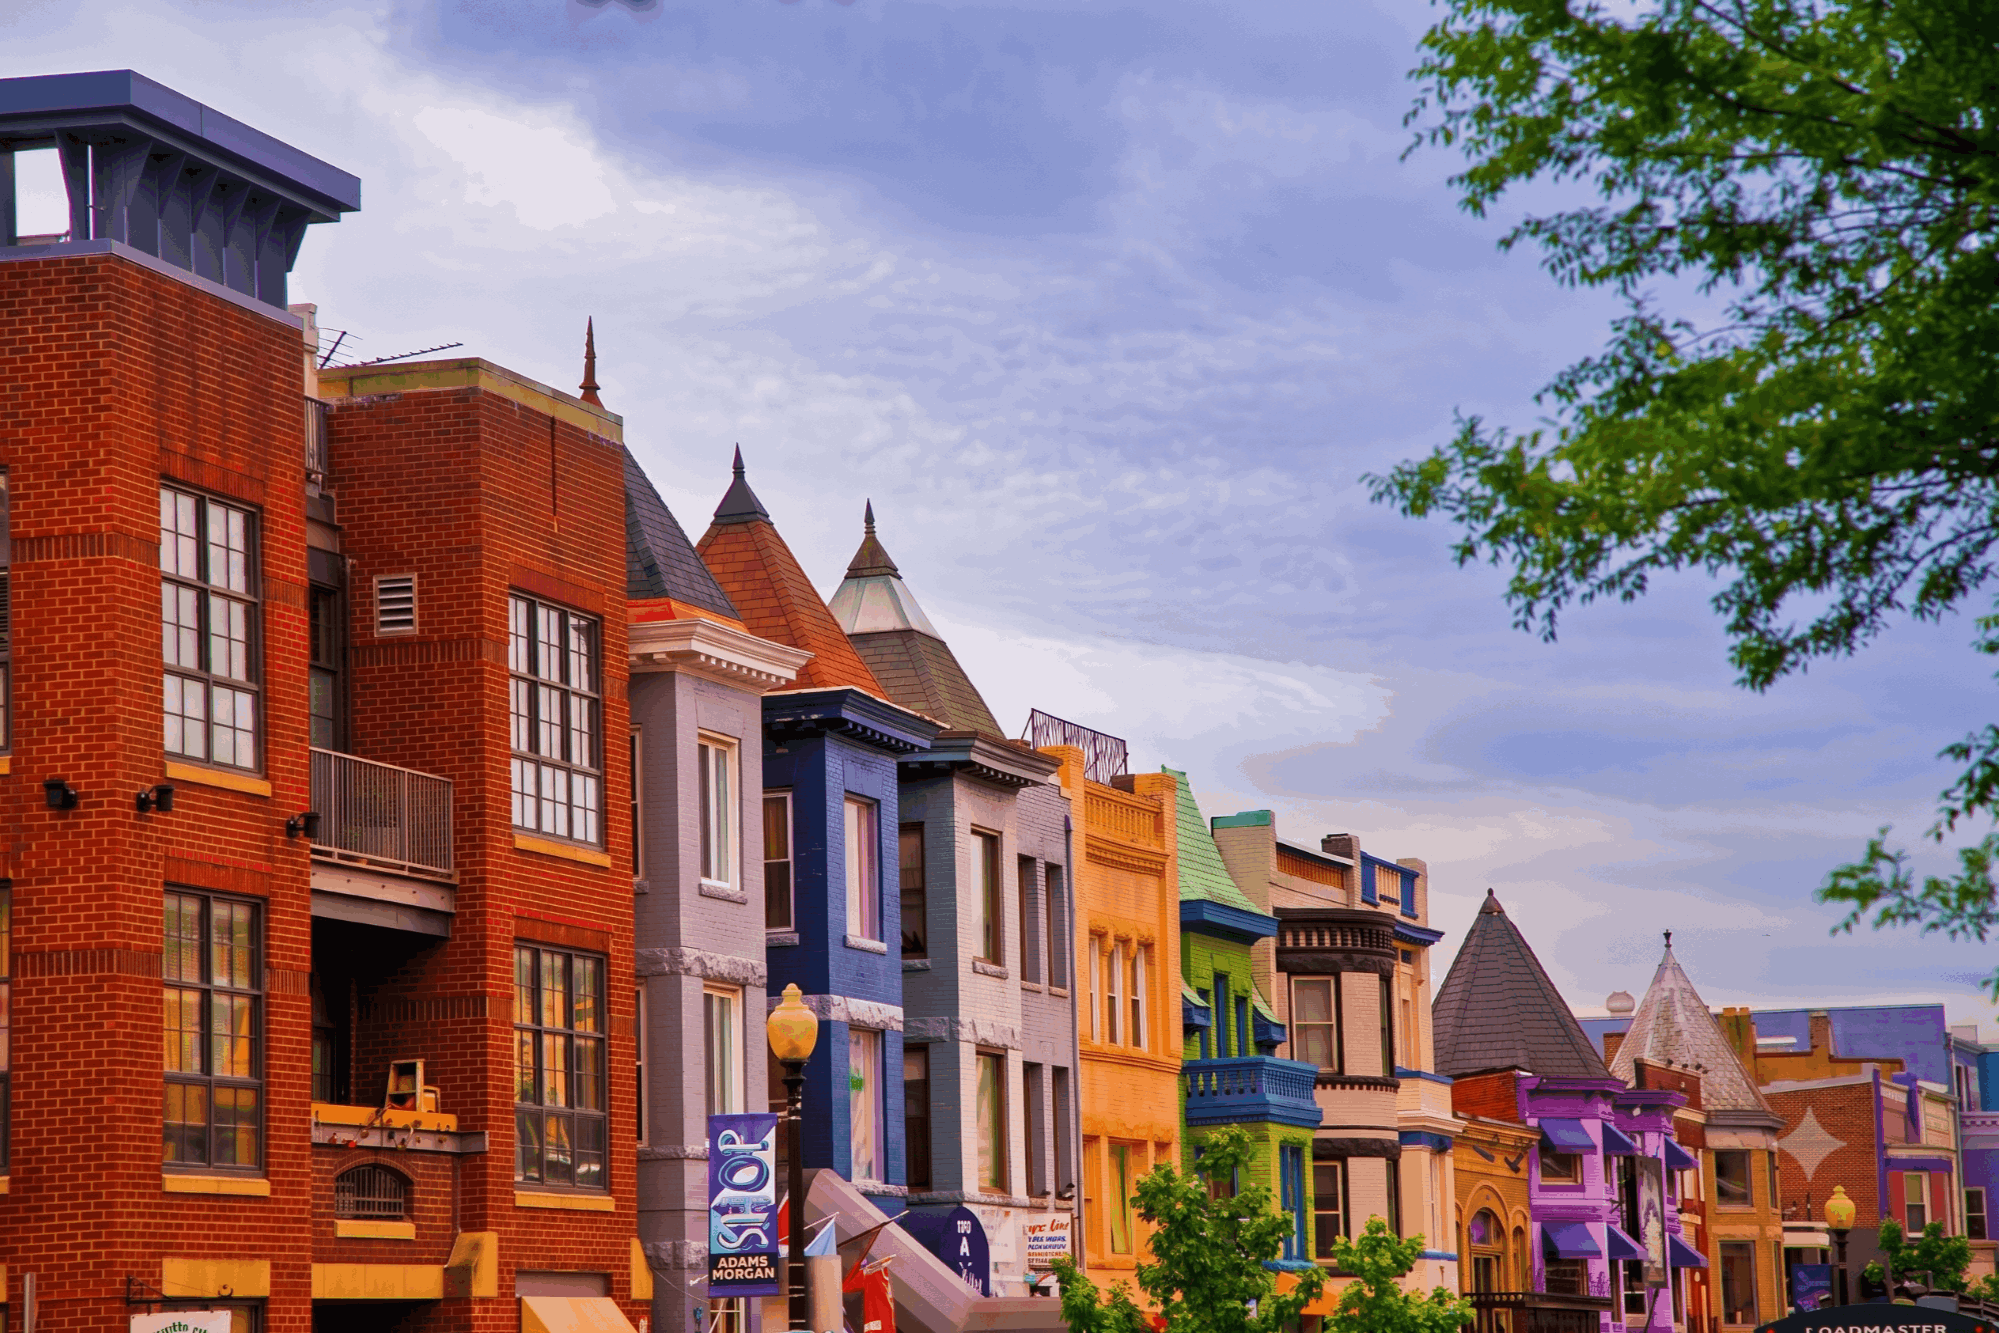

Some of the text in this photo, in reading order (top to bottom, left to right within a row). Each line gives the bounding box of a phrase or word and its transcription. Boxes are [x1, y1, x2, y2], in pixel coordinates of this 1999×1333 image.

[717, 1129, 770, 1250] SHOP
[717, 1255, 768, 1268] ADAMS
[712, 1267, 775, 1280] MORGAN
